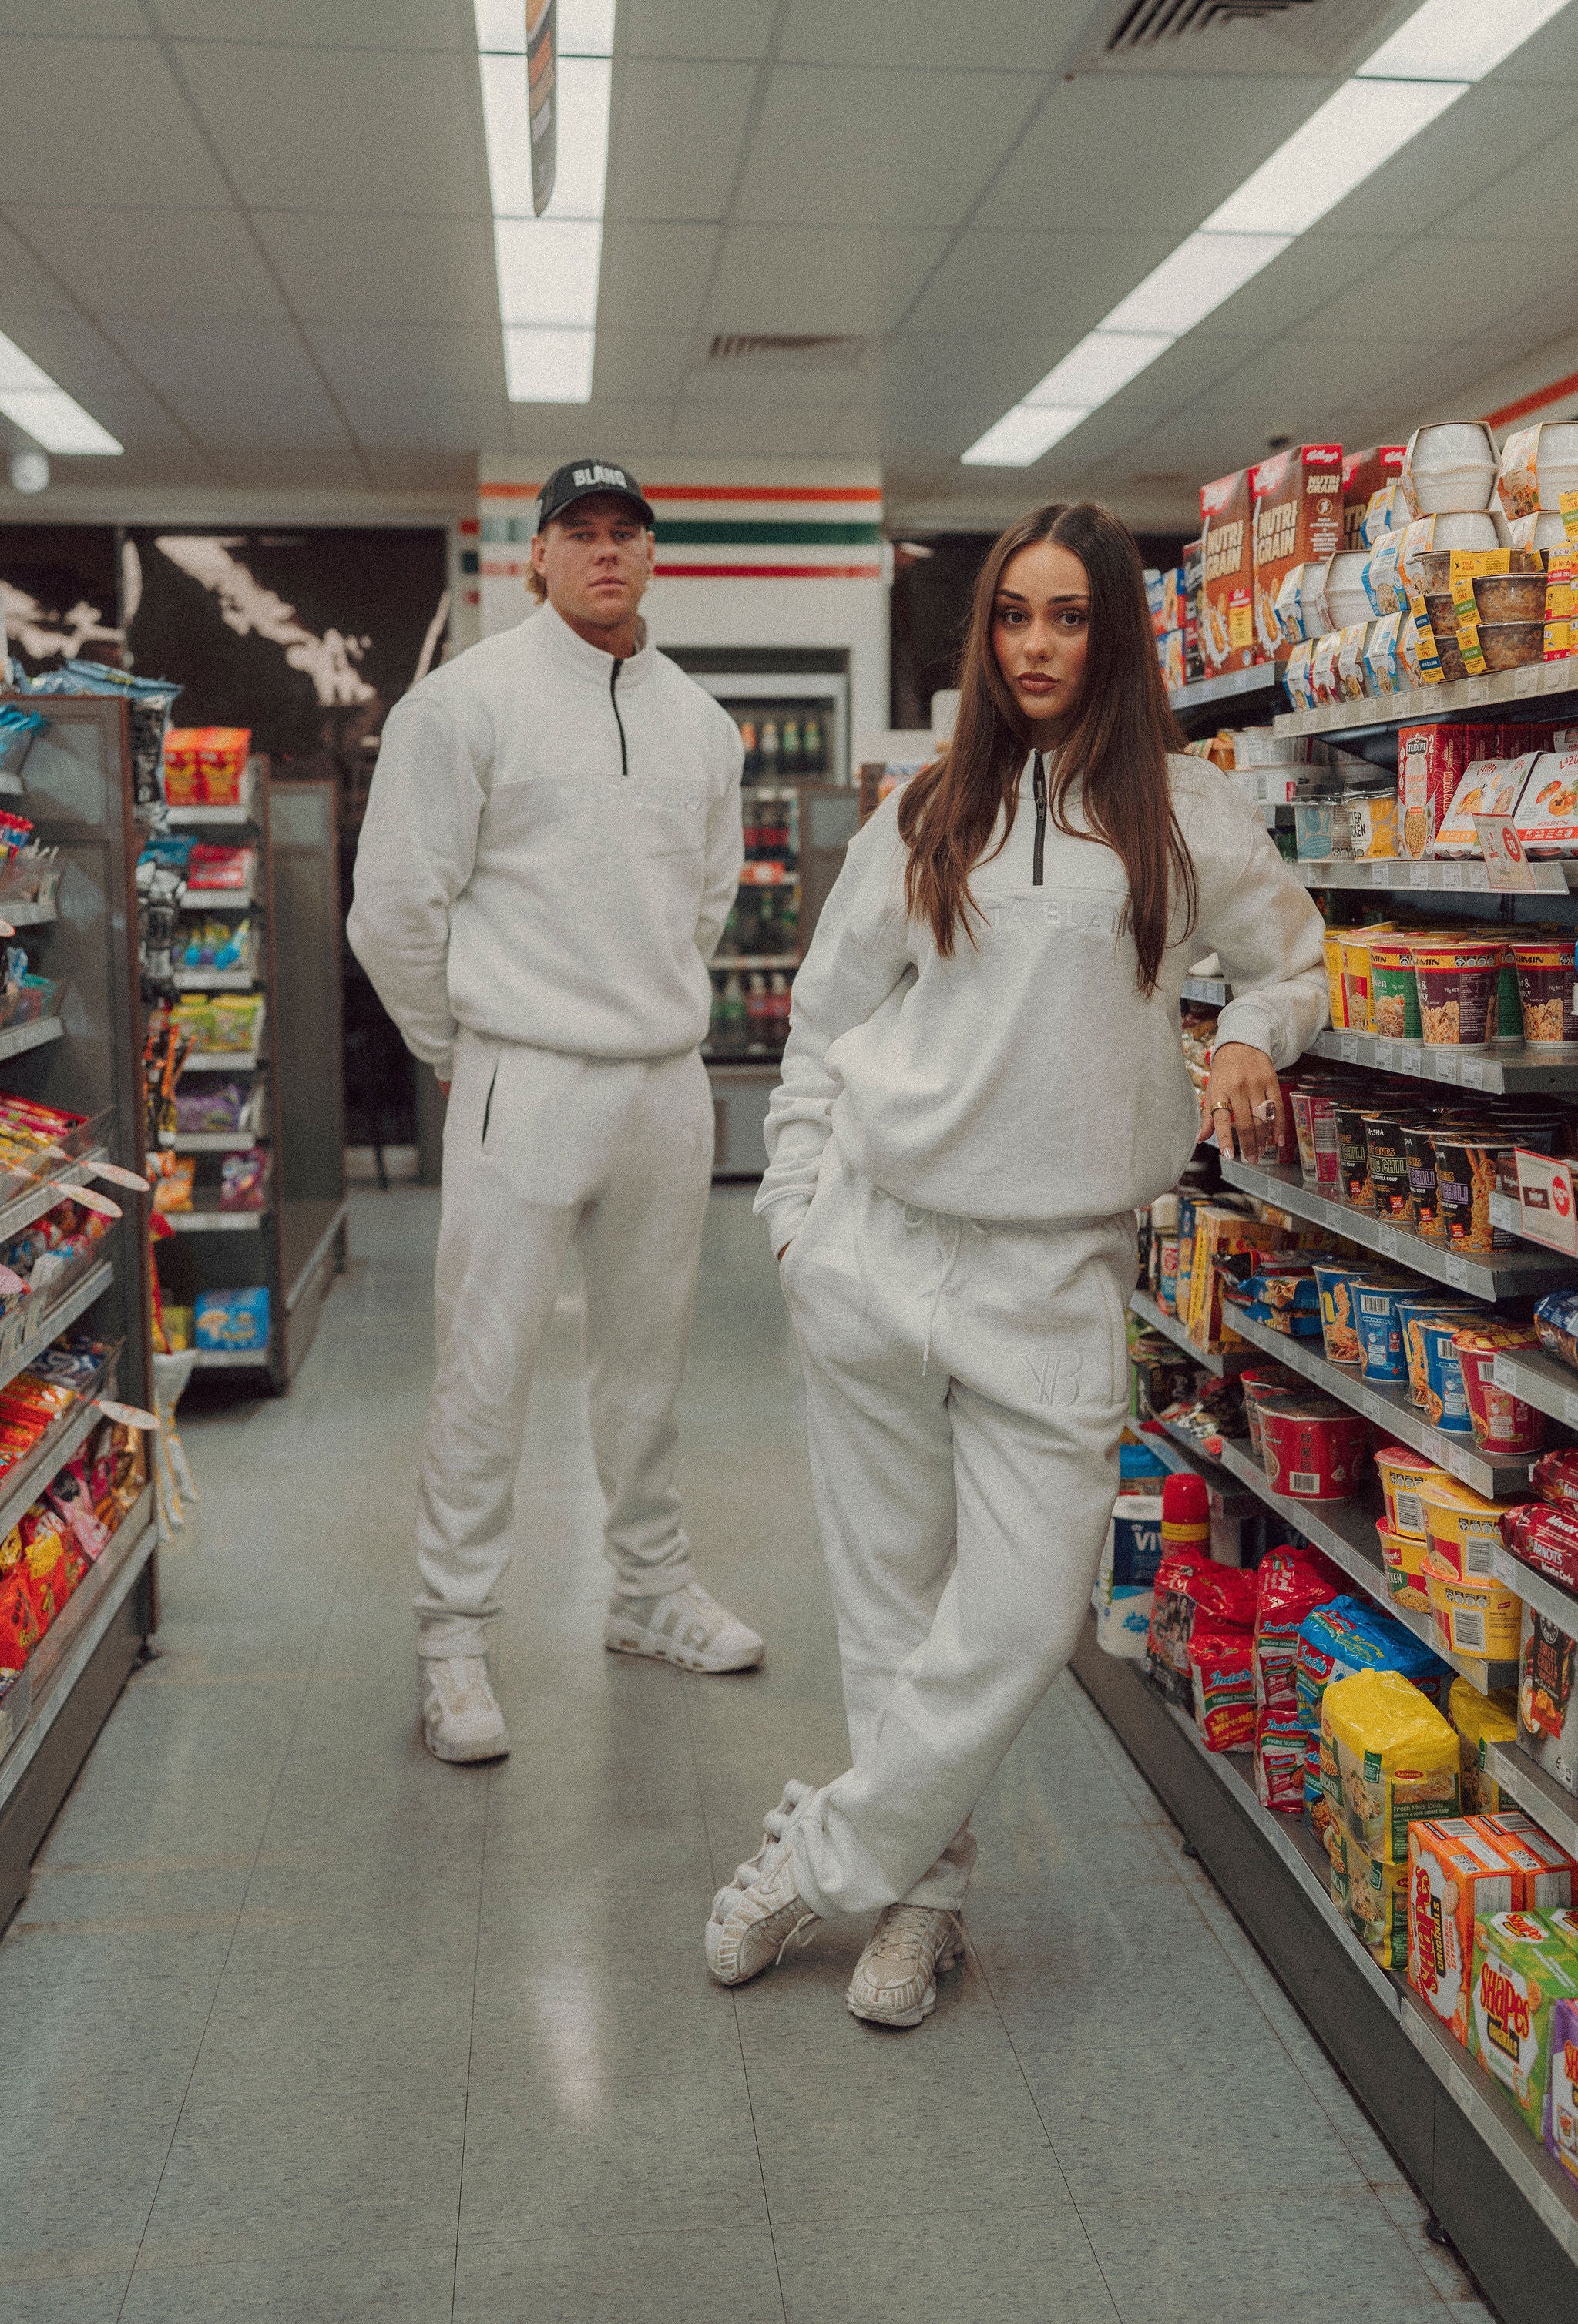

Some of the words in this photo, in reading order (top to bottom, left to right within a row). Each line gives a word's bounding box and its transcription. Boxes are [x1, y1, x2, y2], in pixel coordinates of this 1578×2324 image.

[1258, 500, 1298, 541] NUTRI
[1207, 520, 1244, 557] NUTRI
[1257, 526, 1298, 566] GRAIN
[1206, 544, 1243, 582] GRAIN
[1408, 742, 1428, 755] TRIDENT
[1375, 1146, 1395, 1157] ONES
[1411, 1169, 1435, 1185] CHILI
[1442, 1182, 1469, 1202] CHILI
[1393, 1805, 1412, 1814] Fresh
[1432, 1900, 1445, 1971] ORIGINALS
